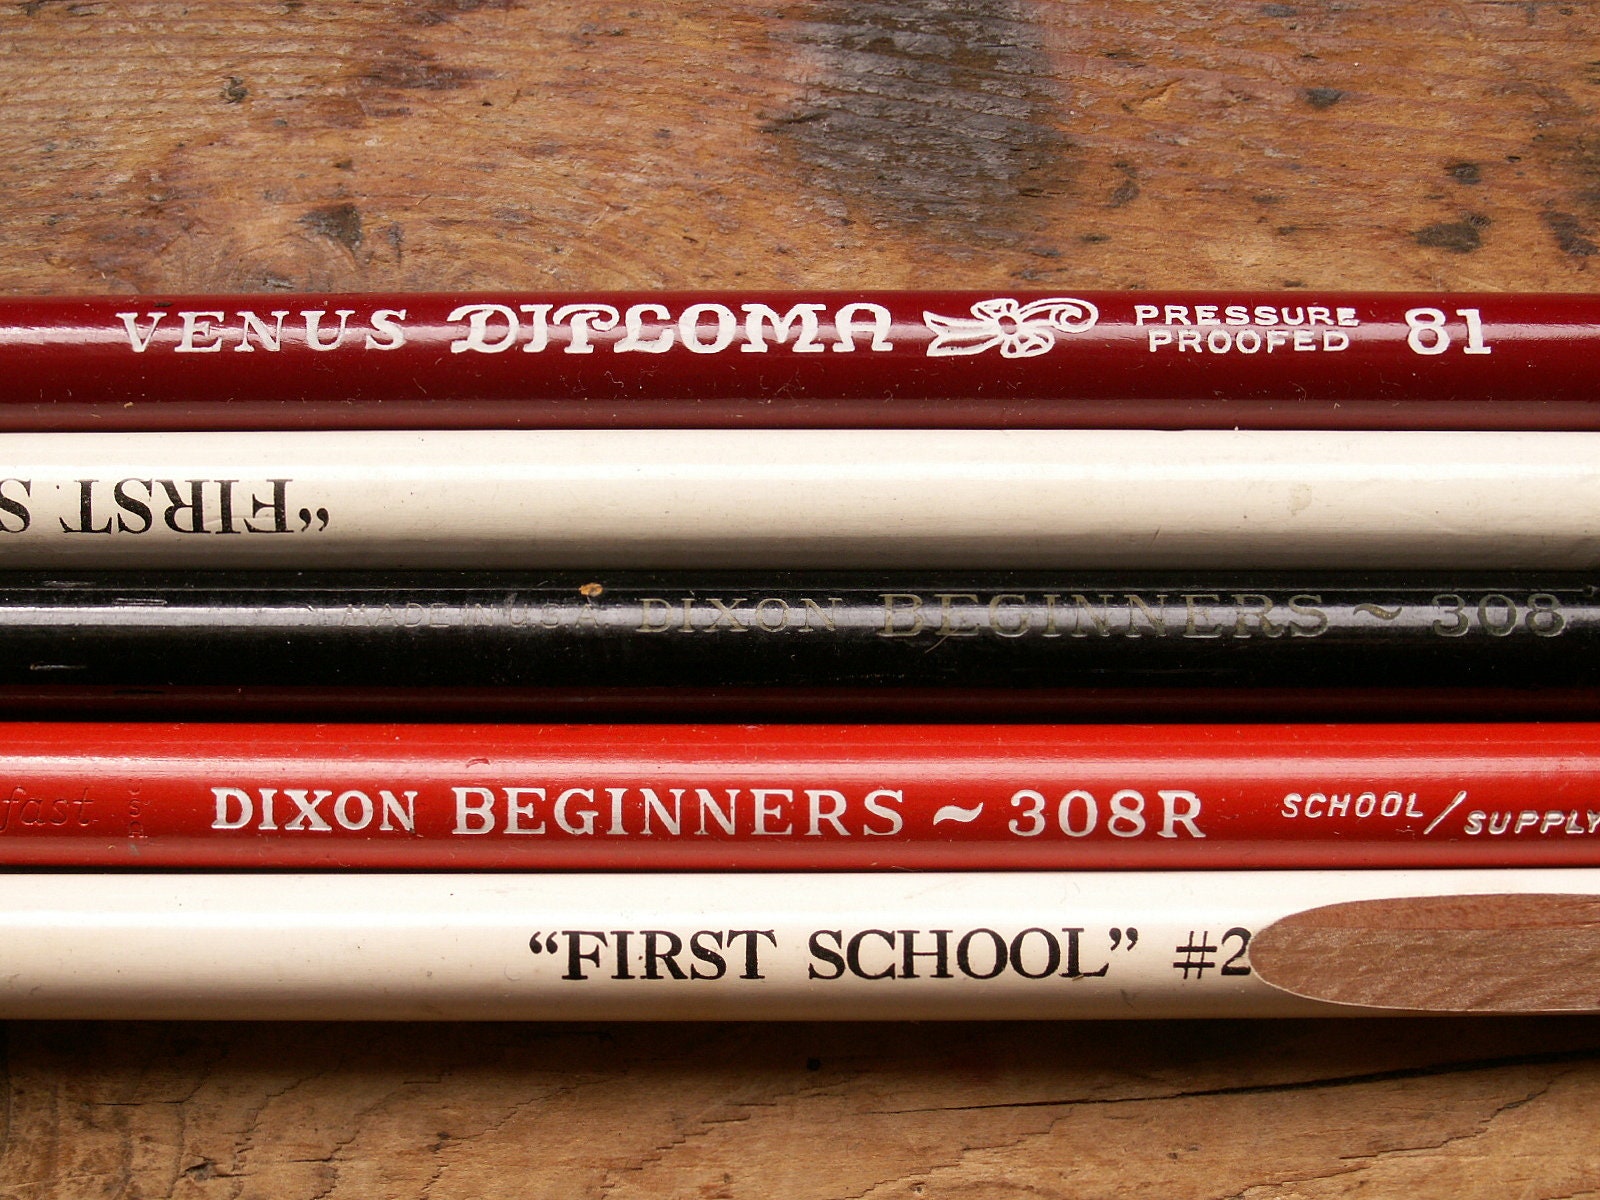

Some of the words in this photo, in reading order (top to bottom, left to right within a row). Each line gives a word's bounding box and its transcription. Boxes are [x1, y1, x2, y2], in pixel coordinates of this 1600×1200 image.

[114, 308, 408, 354] VENUS
[445, 303, 895, 355] DIPLOMA
[1134, 304, 1361, 327] PRESSURE
[1404, 307, 1493, 356] 81
[1147, 328, 1351, 355] PROOFED
[635, 597, 844, 634] DIXON
[877, 592, 1332, 639] BEGINNERS
[1431, 592, 1567, 638] 308
[210, 786, 420, 833] DIXON
[450, 786, 906, 837] BEGINNERS
[1007, 788, 1208, 839] 308R
[1171, 926, 1253, 981] #2
